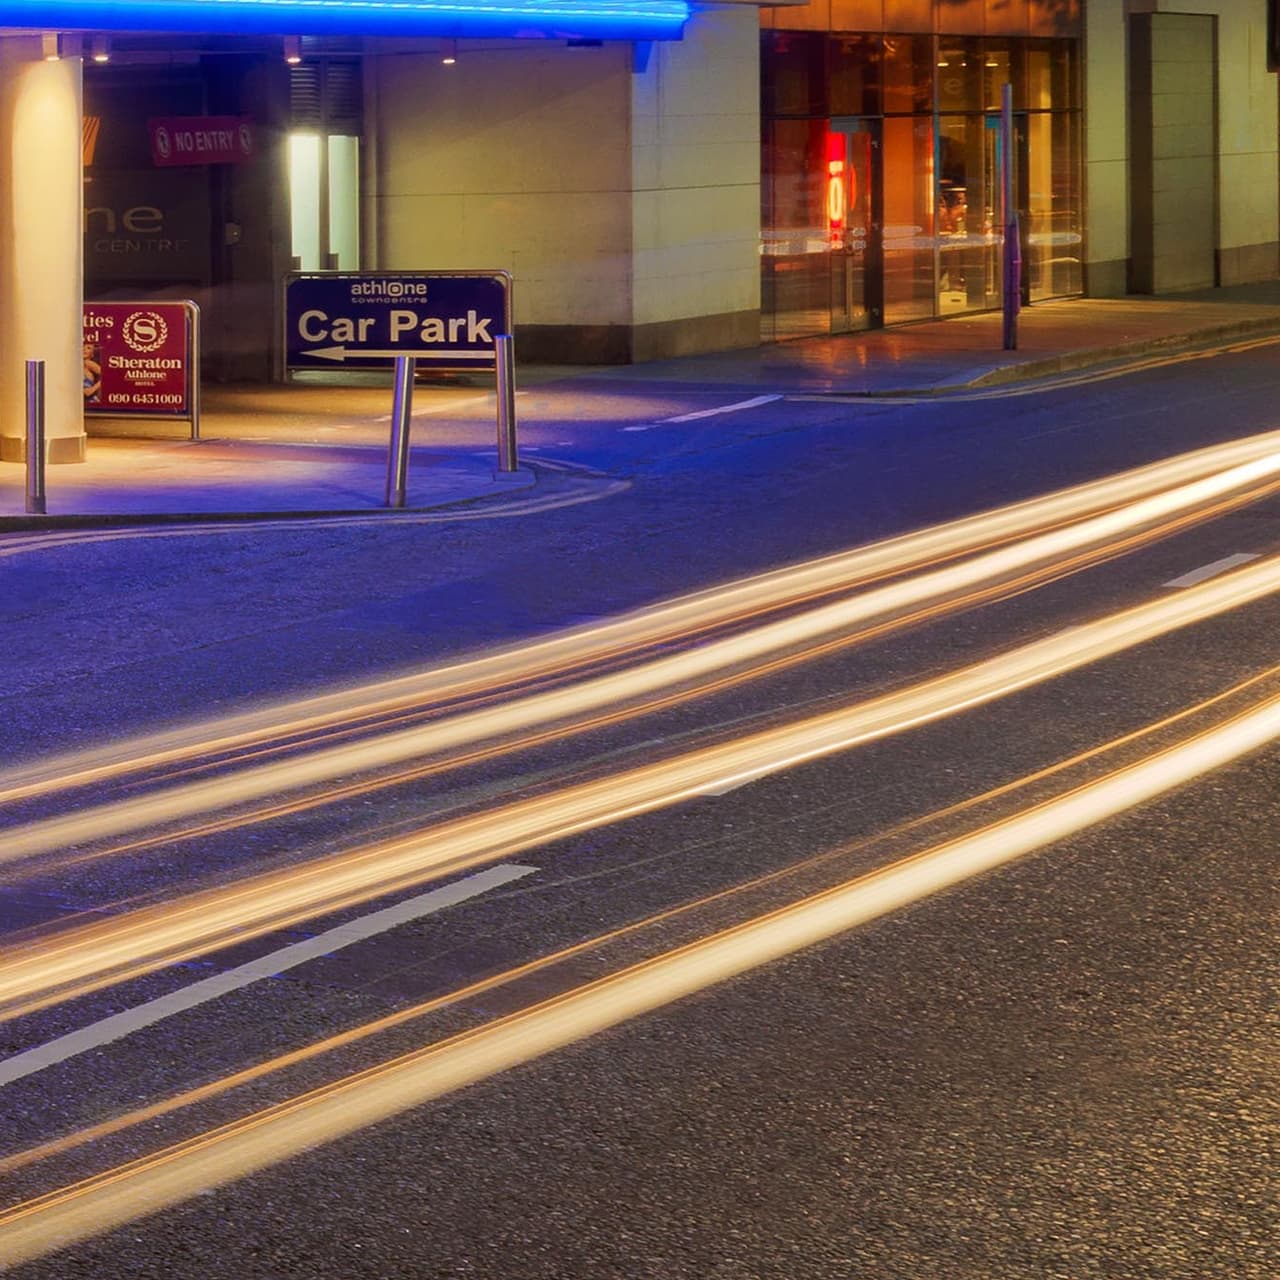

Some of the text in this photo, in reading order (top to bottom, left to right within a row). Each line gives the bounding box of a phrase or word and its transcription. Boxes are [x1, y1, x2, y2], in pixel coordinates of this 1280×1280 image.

[175, 130, 234, 152] NO ENTRY
[298, 309, 493, 343] Car Park
[108, 355, 182, 369] Sheraton
[124, 370, 167, 379] Athlone
[108, 393, 182, 404] 090 6451000
